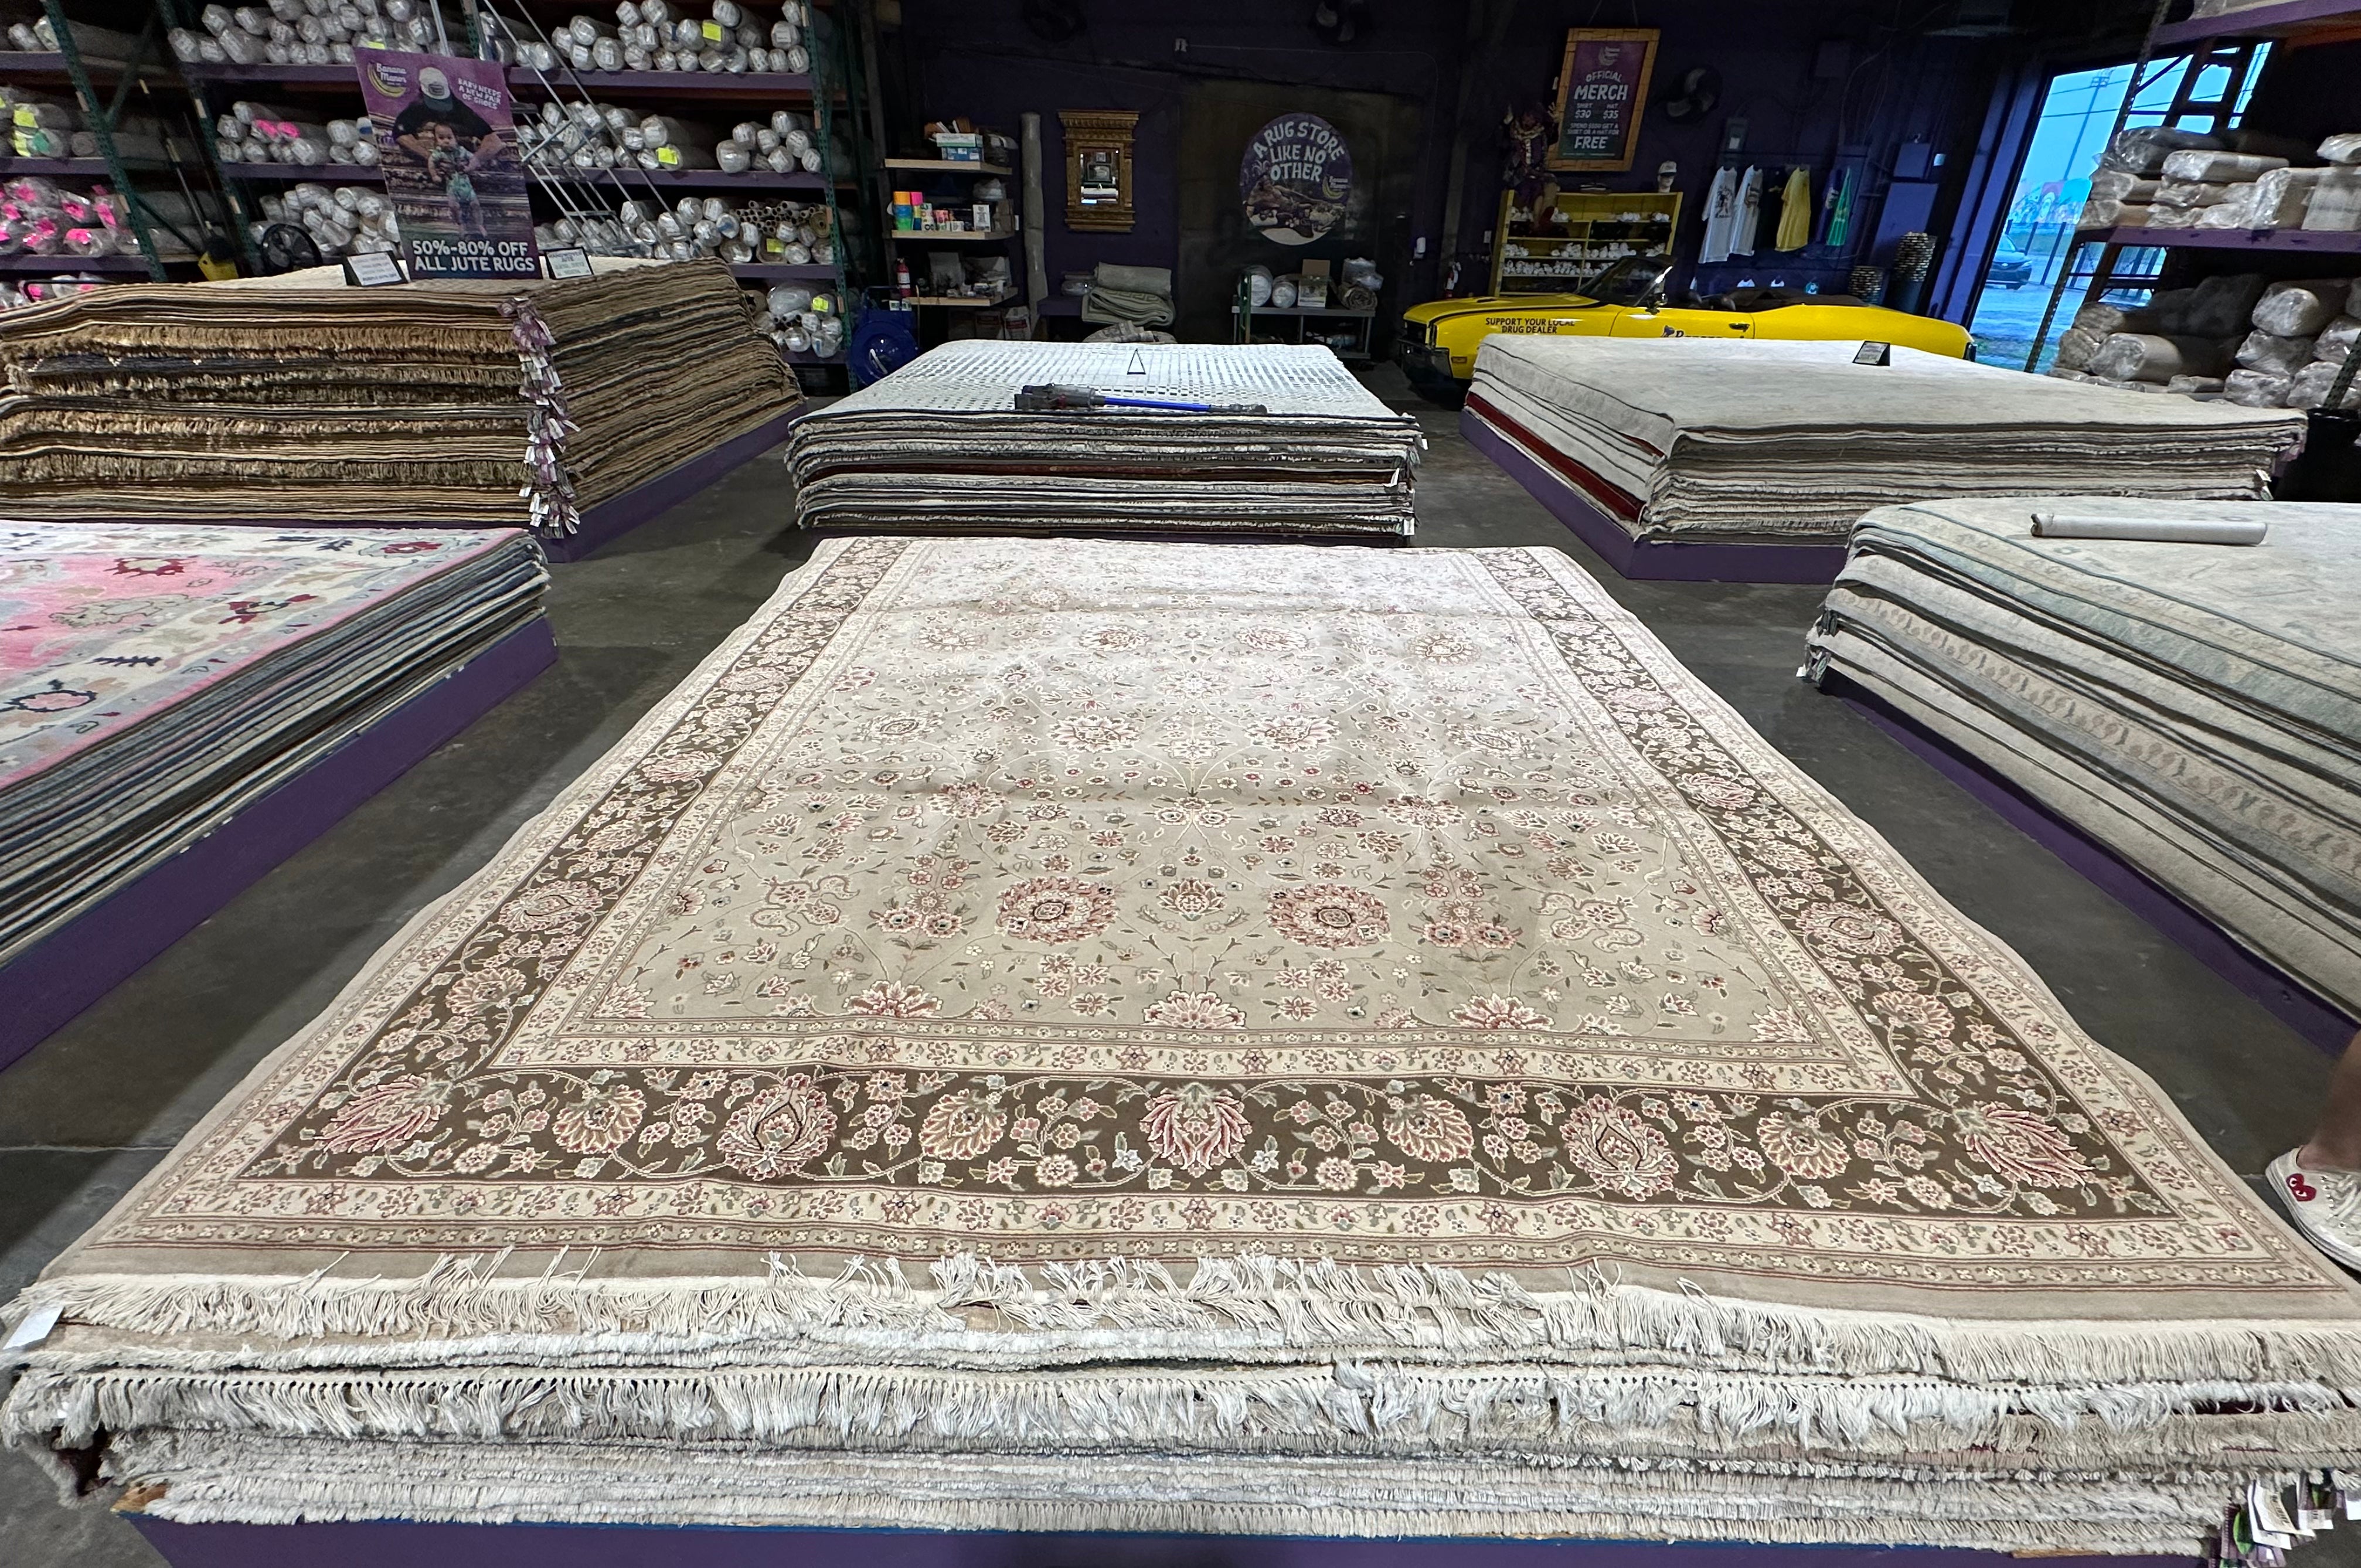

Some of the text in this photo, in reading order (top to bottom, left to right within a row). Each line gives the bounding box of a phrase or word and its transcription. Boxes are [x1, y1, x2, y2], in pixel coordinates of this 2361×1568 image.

[376, 63, 406, 74] Banana
[1586, 70, 1622, 83] OFFICIAL
[466, 87, 482, 98] NEW
[484, 94, 501, 104] PAIR
[478, 85, 501, 98] NEEDS
[1574, 84, 1628, 100] MERCH
[474, 97, 498, 110] SHOES
[1575, 109, 1619, 120] $30 $35
[1253, 121, 1345, 161] A RUG STORE
[1574, 136, 1608, 149] FREE
[1270, 144, 1326, 164] LIKE NO
[1270, 162, 1322, 182] OTHER
[412, 240, 528, 256] 50%-80% OFF
[414, 256, 447, 271] ALL
[451, 257, 491, 271] JUTE
[492, 257, 536, 271] RUGS
[1502, 325, 1524, 334] DRUG
